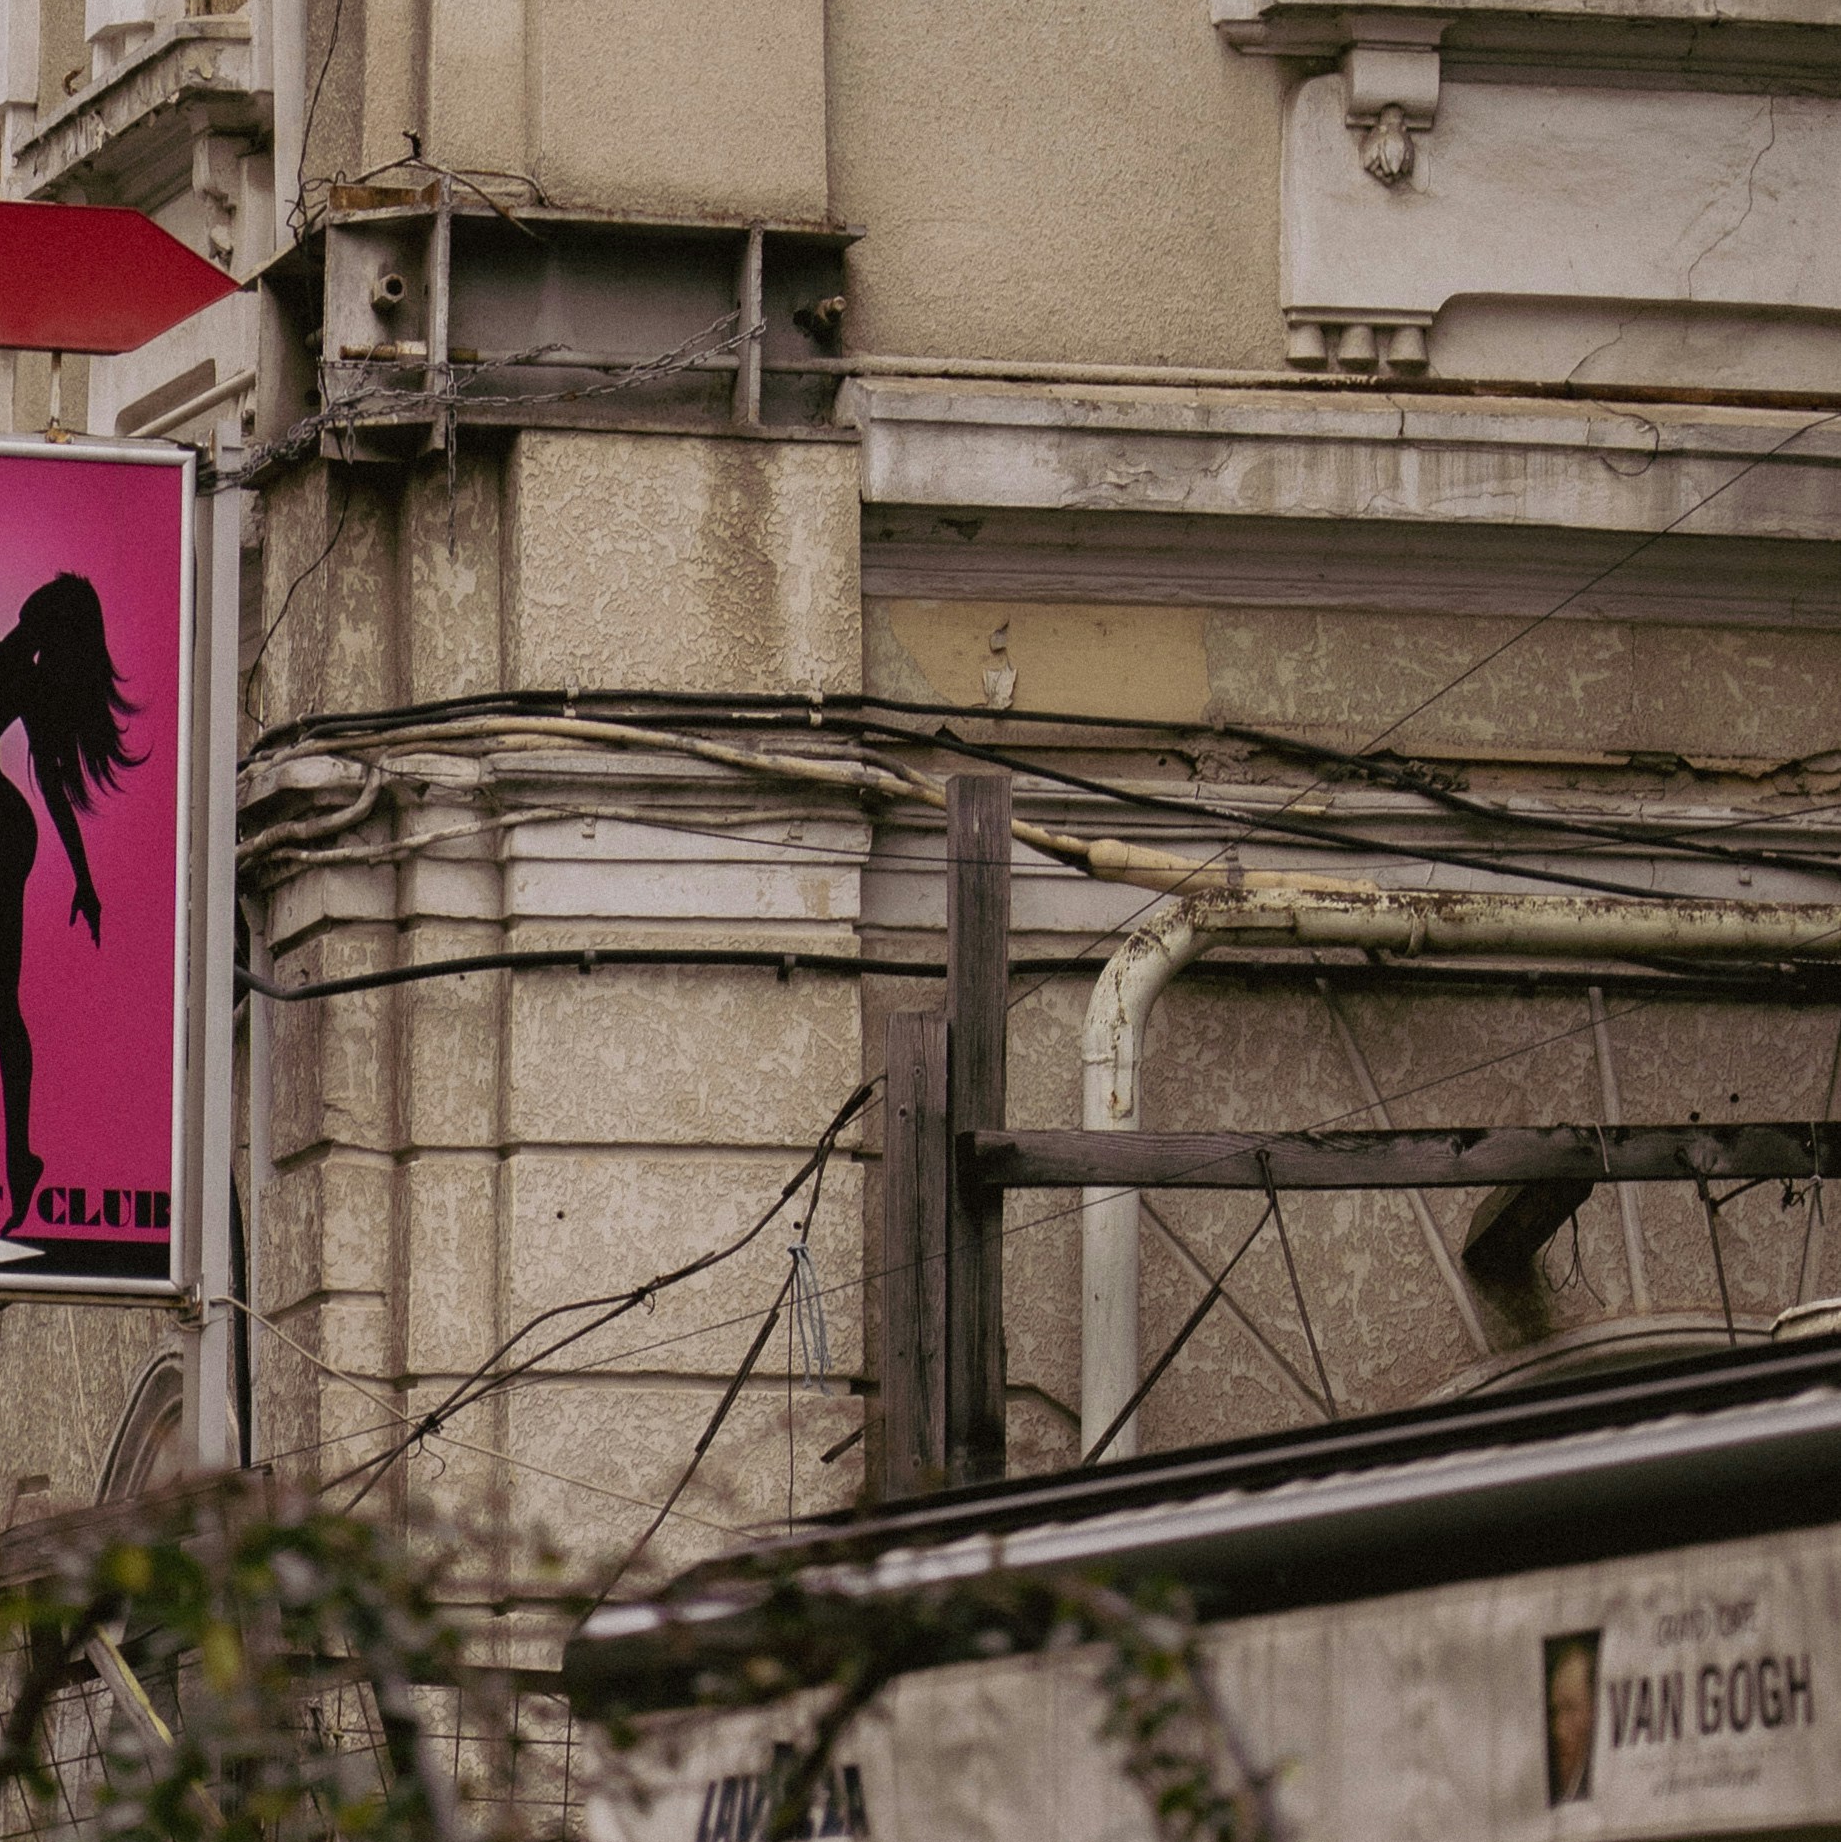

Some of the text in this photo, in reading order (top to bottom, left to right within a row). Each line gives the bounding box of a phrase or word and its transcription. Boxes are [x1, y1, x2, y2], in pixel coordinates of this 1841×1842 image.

[36, 1186, 171, 1229] CLUB
[1608, 1652, 1815, 1749] VAN GOGH
